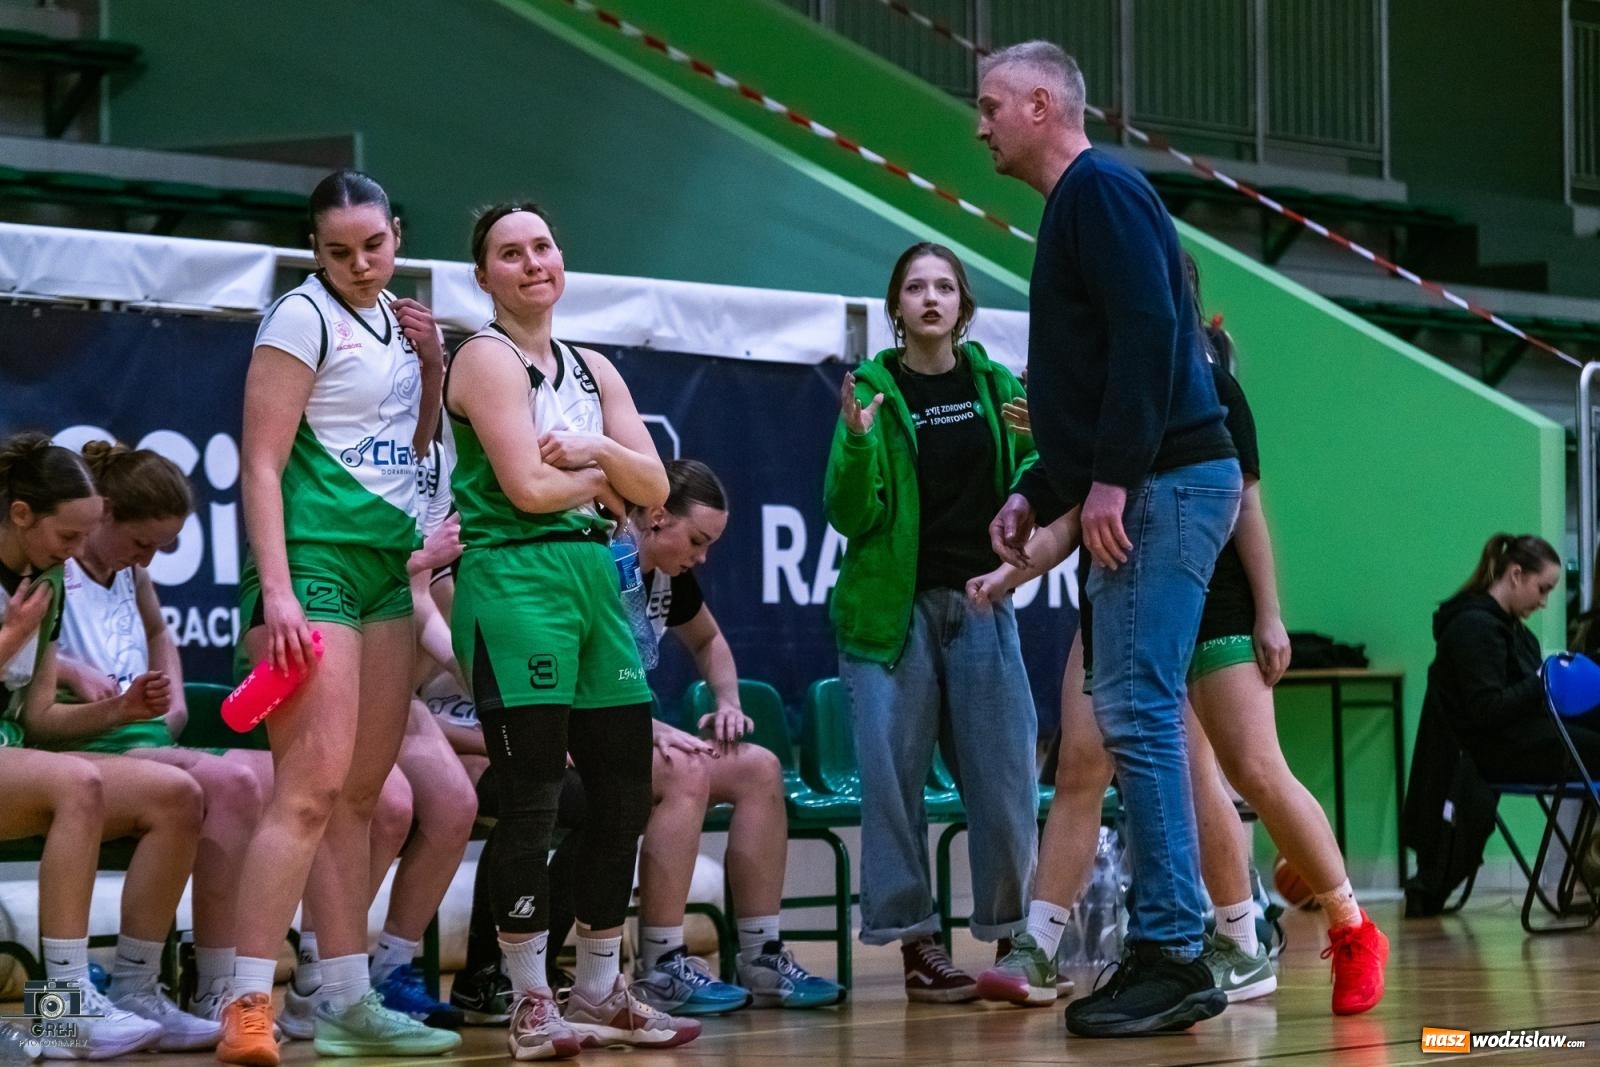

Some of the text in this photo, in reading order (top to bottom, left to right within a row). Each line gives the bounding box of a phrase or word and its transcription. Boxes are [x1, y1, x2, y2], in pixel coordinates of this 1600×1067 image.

[934, 411, 974, 426] SPORTOWO
[940, 401, 972, 414] ZDROWO
[528, 653, 559, 690] 3
[227, 671, 256, 703] Tacx
